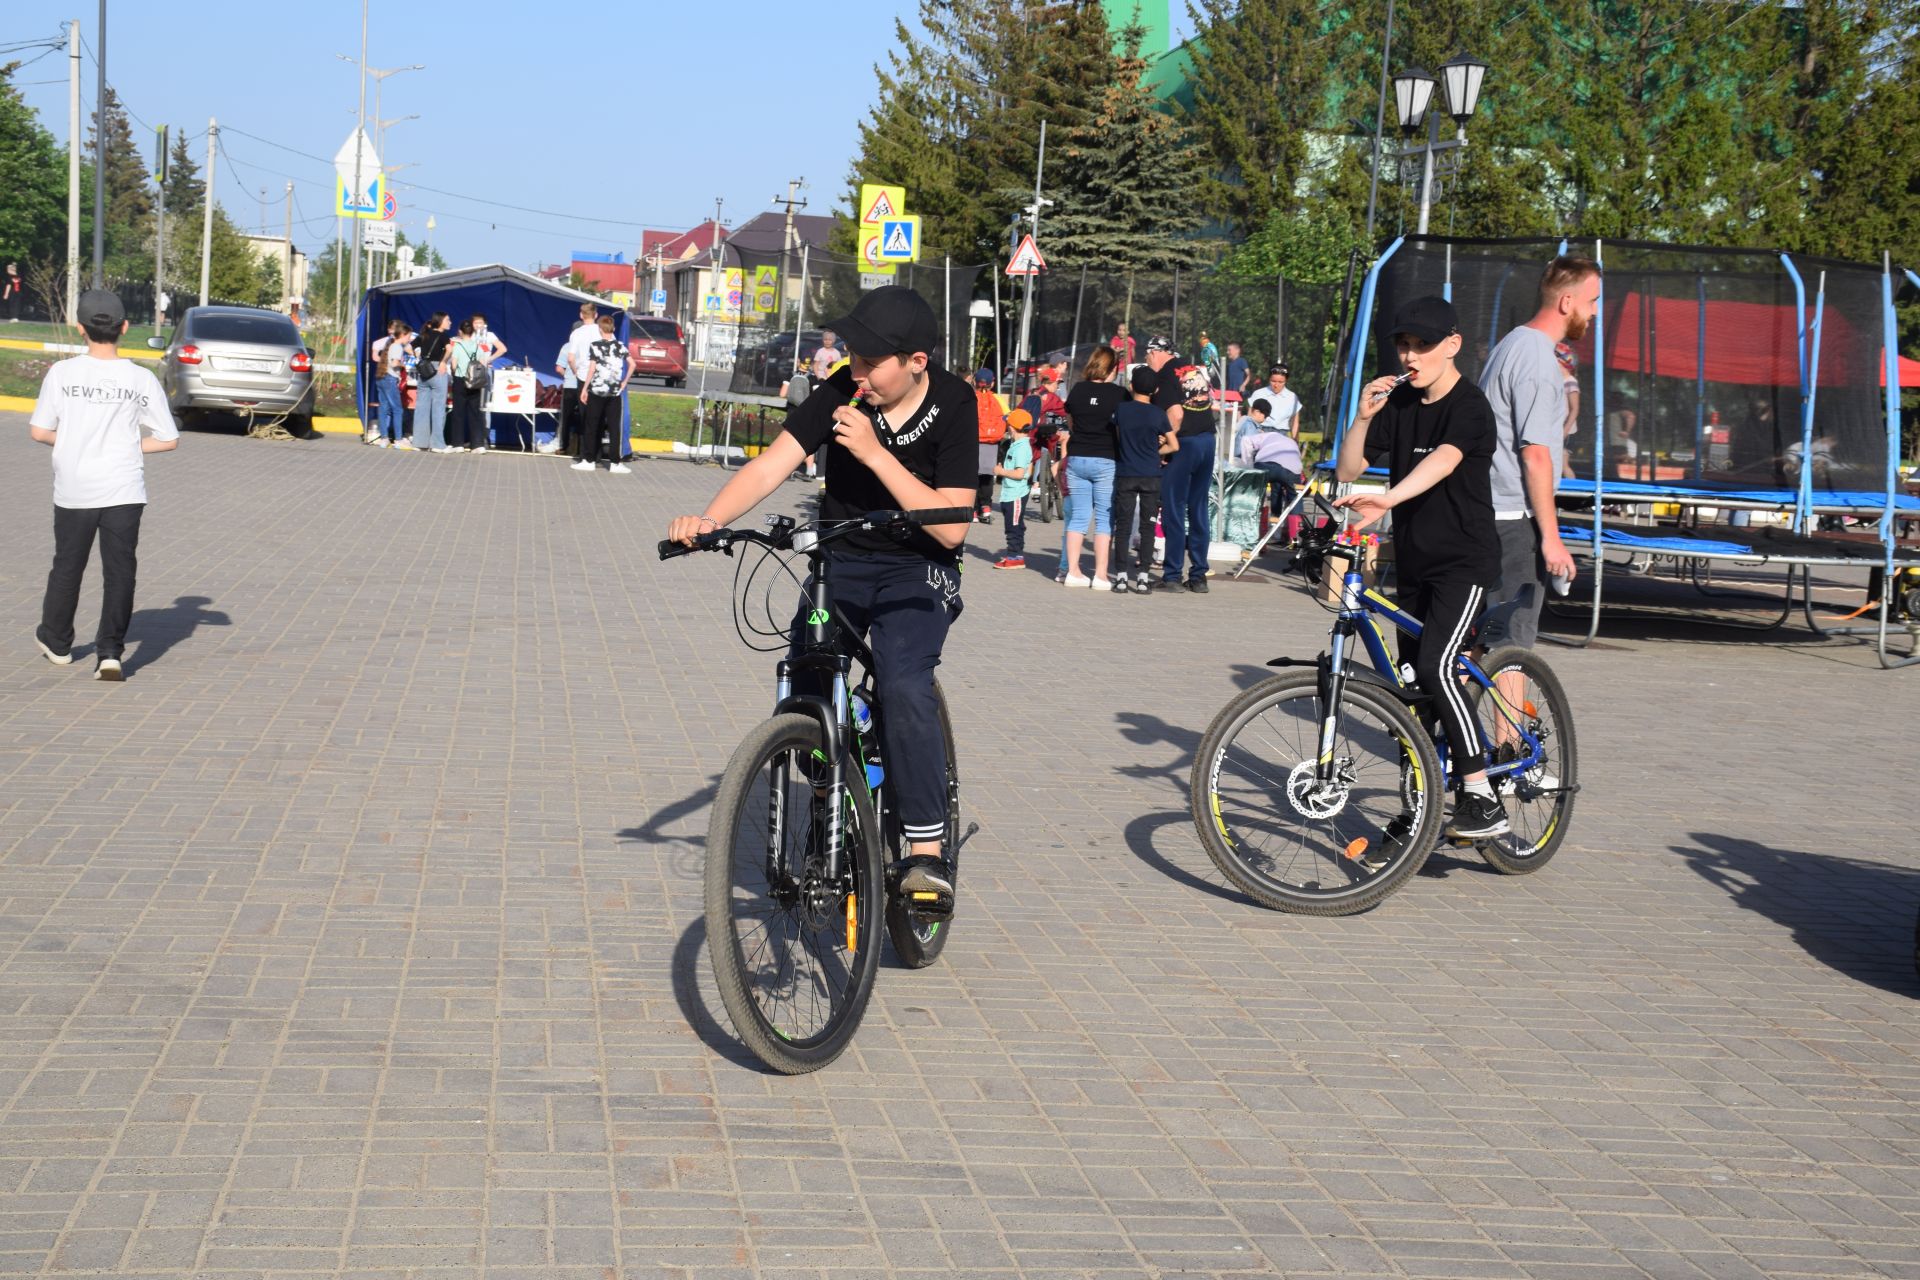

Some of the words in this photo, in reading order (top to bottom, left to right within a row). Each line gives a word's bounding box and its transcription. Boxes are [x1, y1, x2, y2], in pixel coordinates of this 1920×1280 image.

[655, 291, 664, 302] P
[761, 295, 771, 303] 20
[896, 404, 940, 446] CREATIVE
